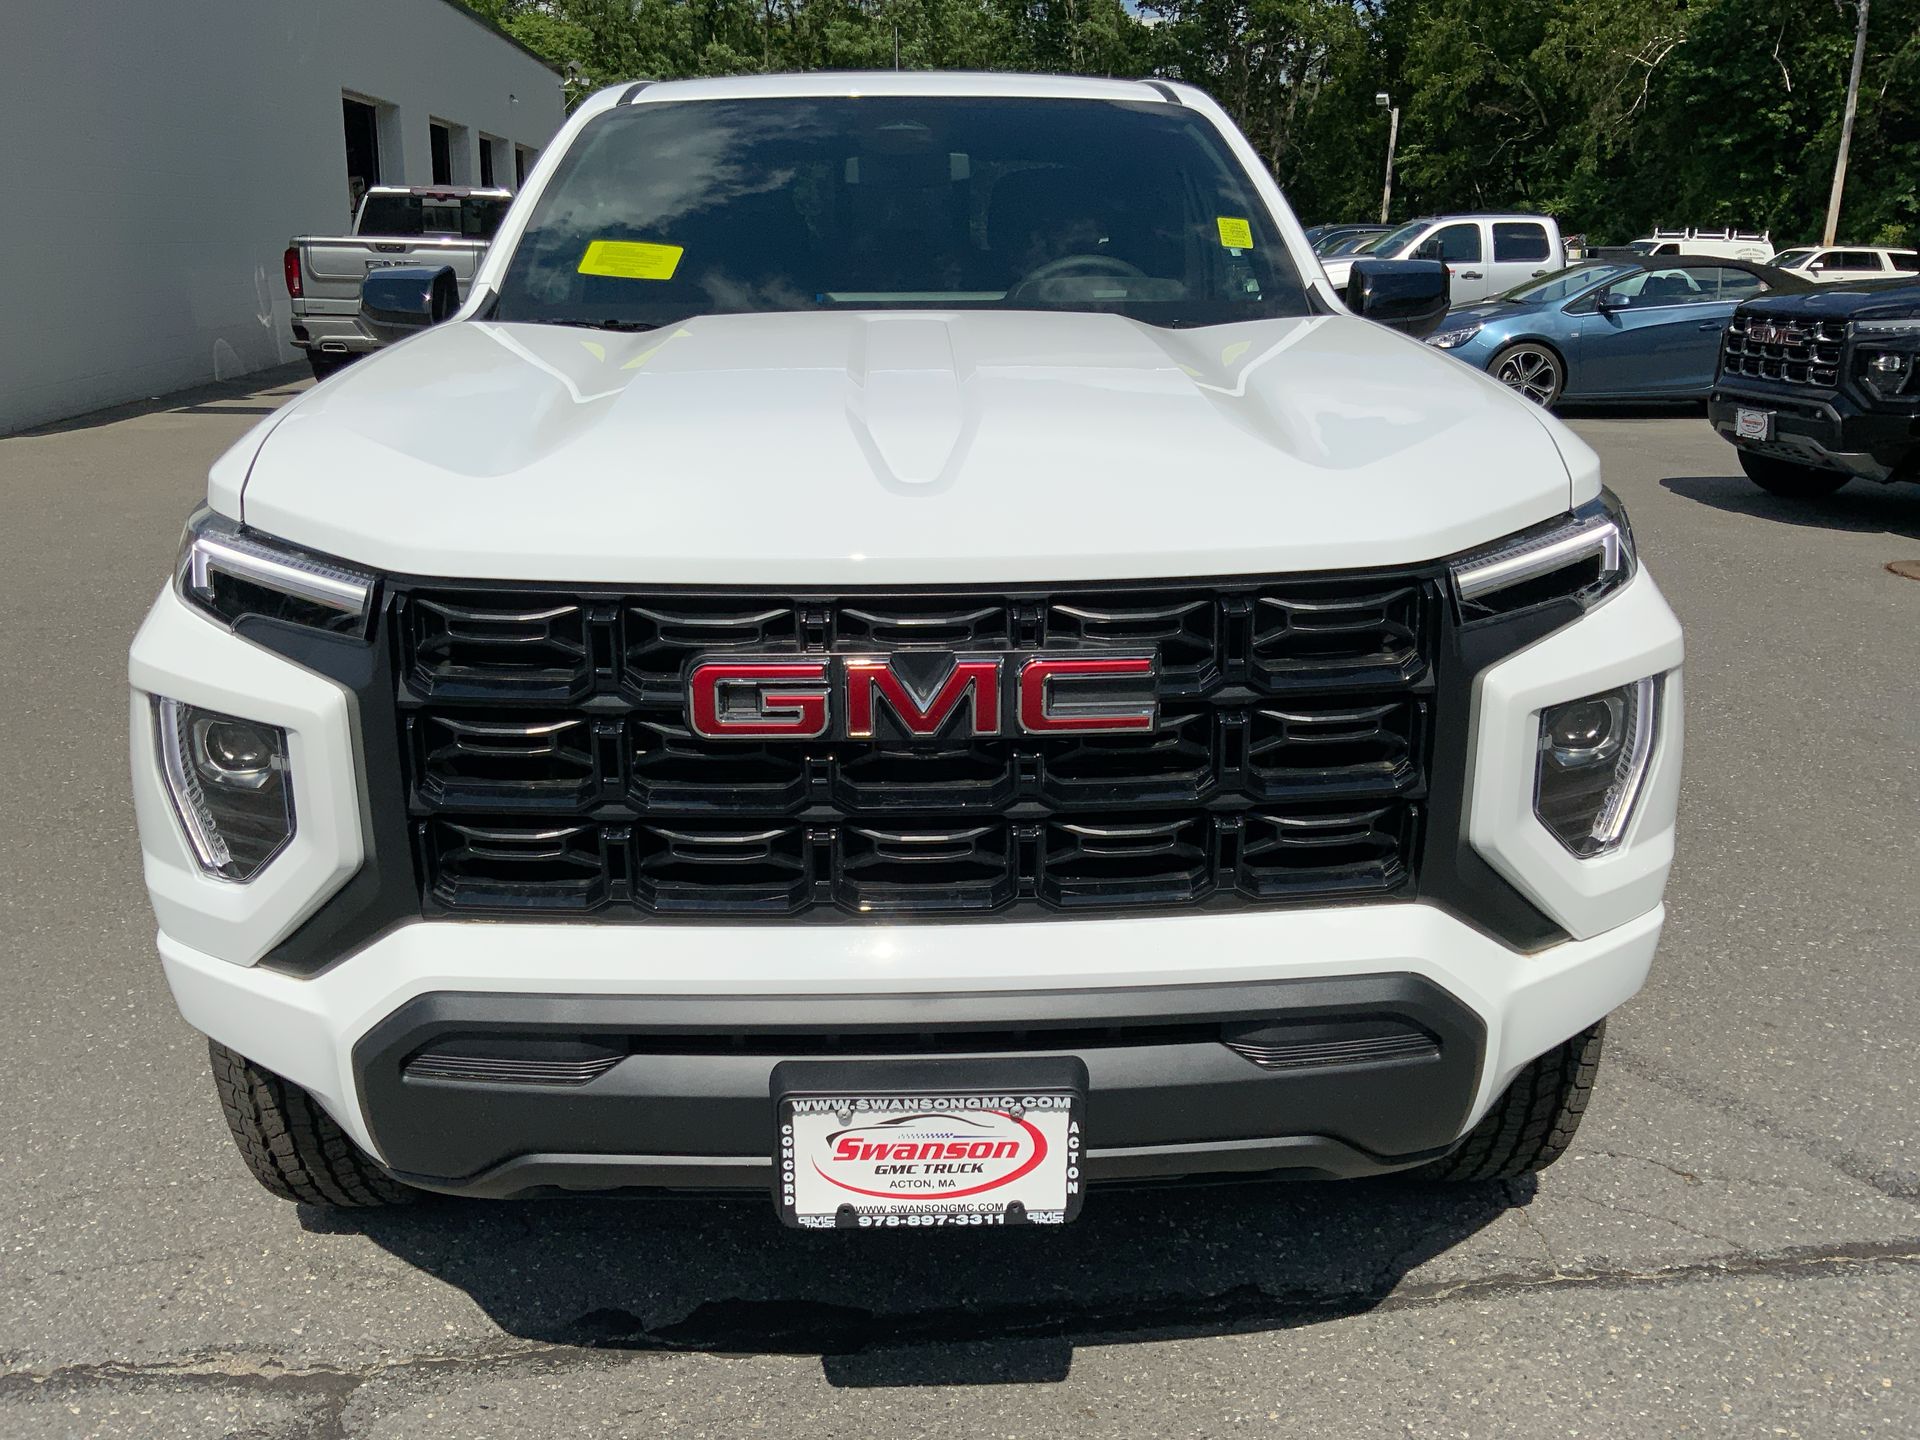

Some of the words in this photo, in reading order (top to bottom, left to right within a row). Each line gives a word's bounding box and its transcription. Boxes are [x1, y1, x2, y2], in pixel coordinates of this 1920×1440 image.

[1749, 326, 1804, 346] GMC
[689, 656, 1156, 738] GMC
[792, 1097, 1071, 1112] WWW.SWANSONGMC.COM
[833, 1137, 1020, 1162] Swanson
[1066, 1121, 1080, 1194] ACTON
[781, 1124, 795, 1206] CONCORD
[874, 1163, 919, 1175] GMC
[923, 1162, 984, 1174] TRUCK
[889, 1179, 935, 1189] ACTON,
[938, 1179, 957, 1188] MA
[855, 1202, 1005, 1214] WWW.SWANSONGMC.COM
[797, 1216, 836, 1224] GMC
[858, 1214, 1005, 1227] 978-897-3311
[1026, 1212, 1065, 1220] GMC
